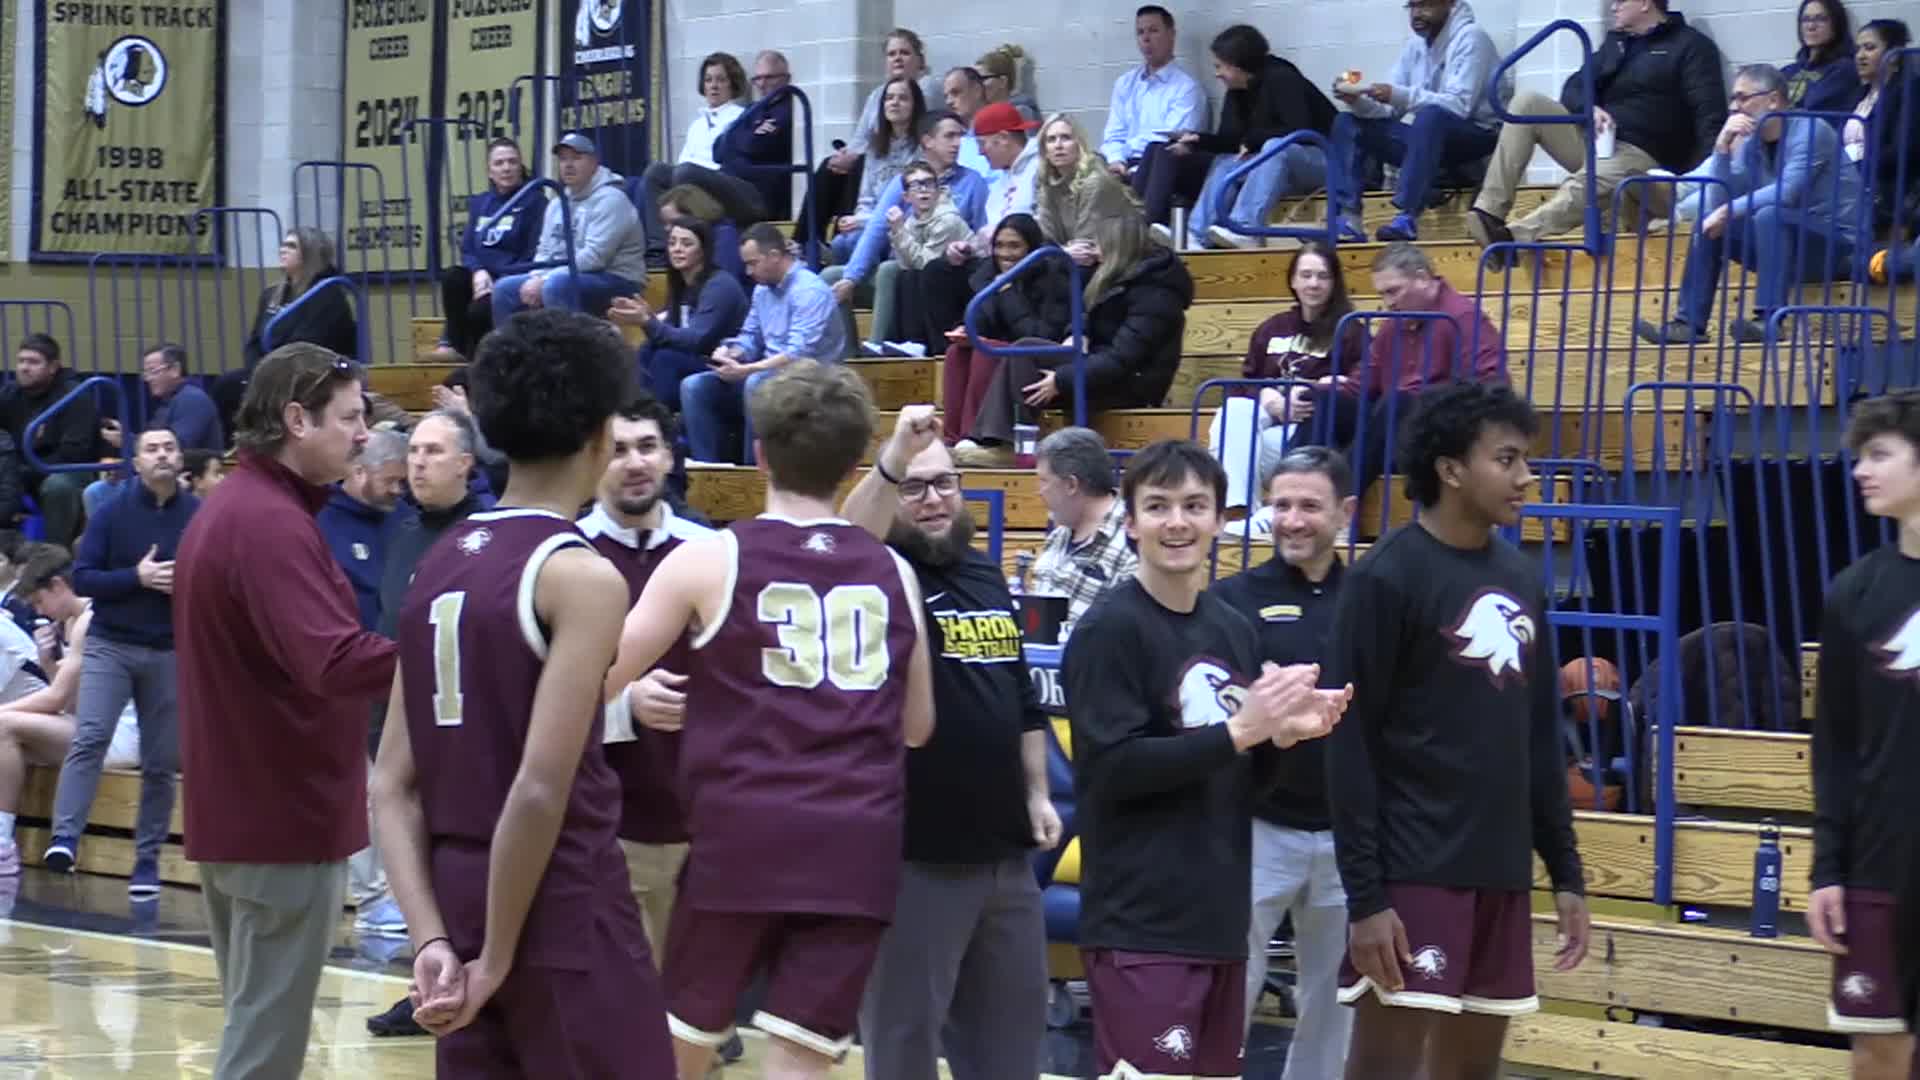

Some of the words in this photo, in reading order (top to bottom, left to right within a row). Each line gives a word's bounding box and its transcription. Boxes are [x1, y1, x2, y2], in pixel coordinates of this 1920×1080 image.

[55, 2, 134, 25] SPRING
[140, 6, 213, 28] TRACK
[356, 96, 419, 148] 2024
[97, 146, 163, 169] 1998
[64, 179, 199, 203] ALL-STATE
[50, 211, 209, 236] CHAMPIONS
[757, 581, 889, 691] 30
[429, 590, 467, 726] 1
